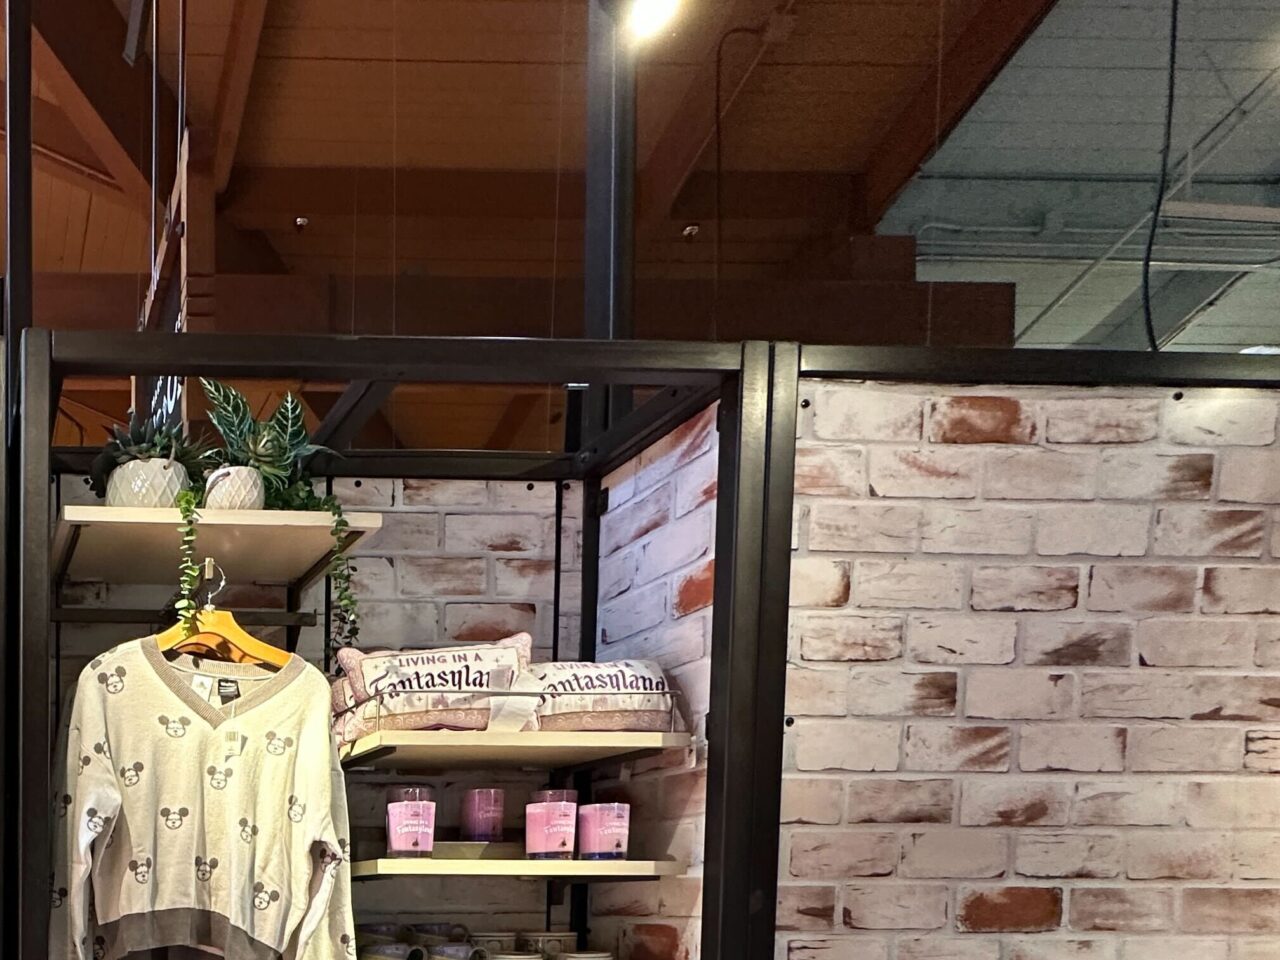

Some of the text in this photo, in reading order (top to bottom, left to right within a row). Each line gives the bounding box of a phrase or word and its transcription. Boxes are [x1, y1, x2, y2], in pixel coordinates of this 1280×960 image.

[398, 652, 483, 668] LIVING IN A
